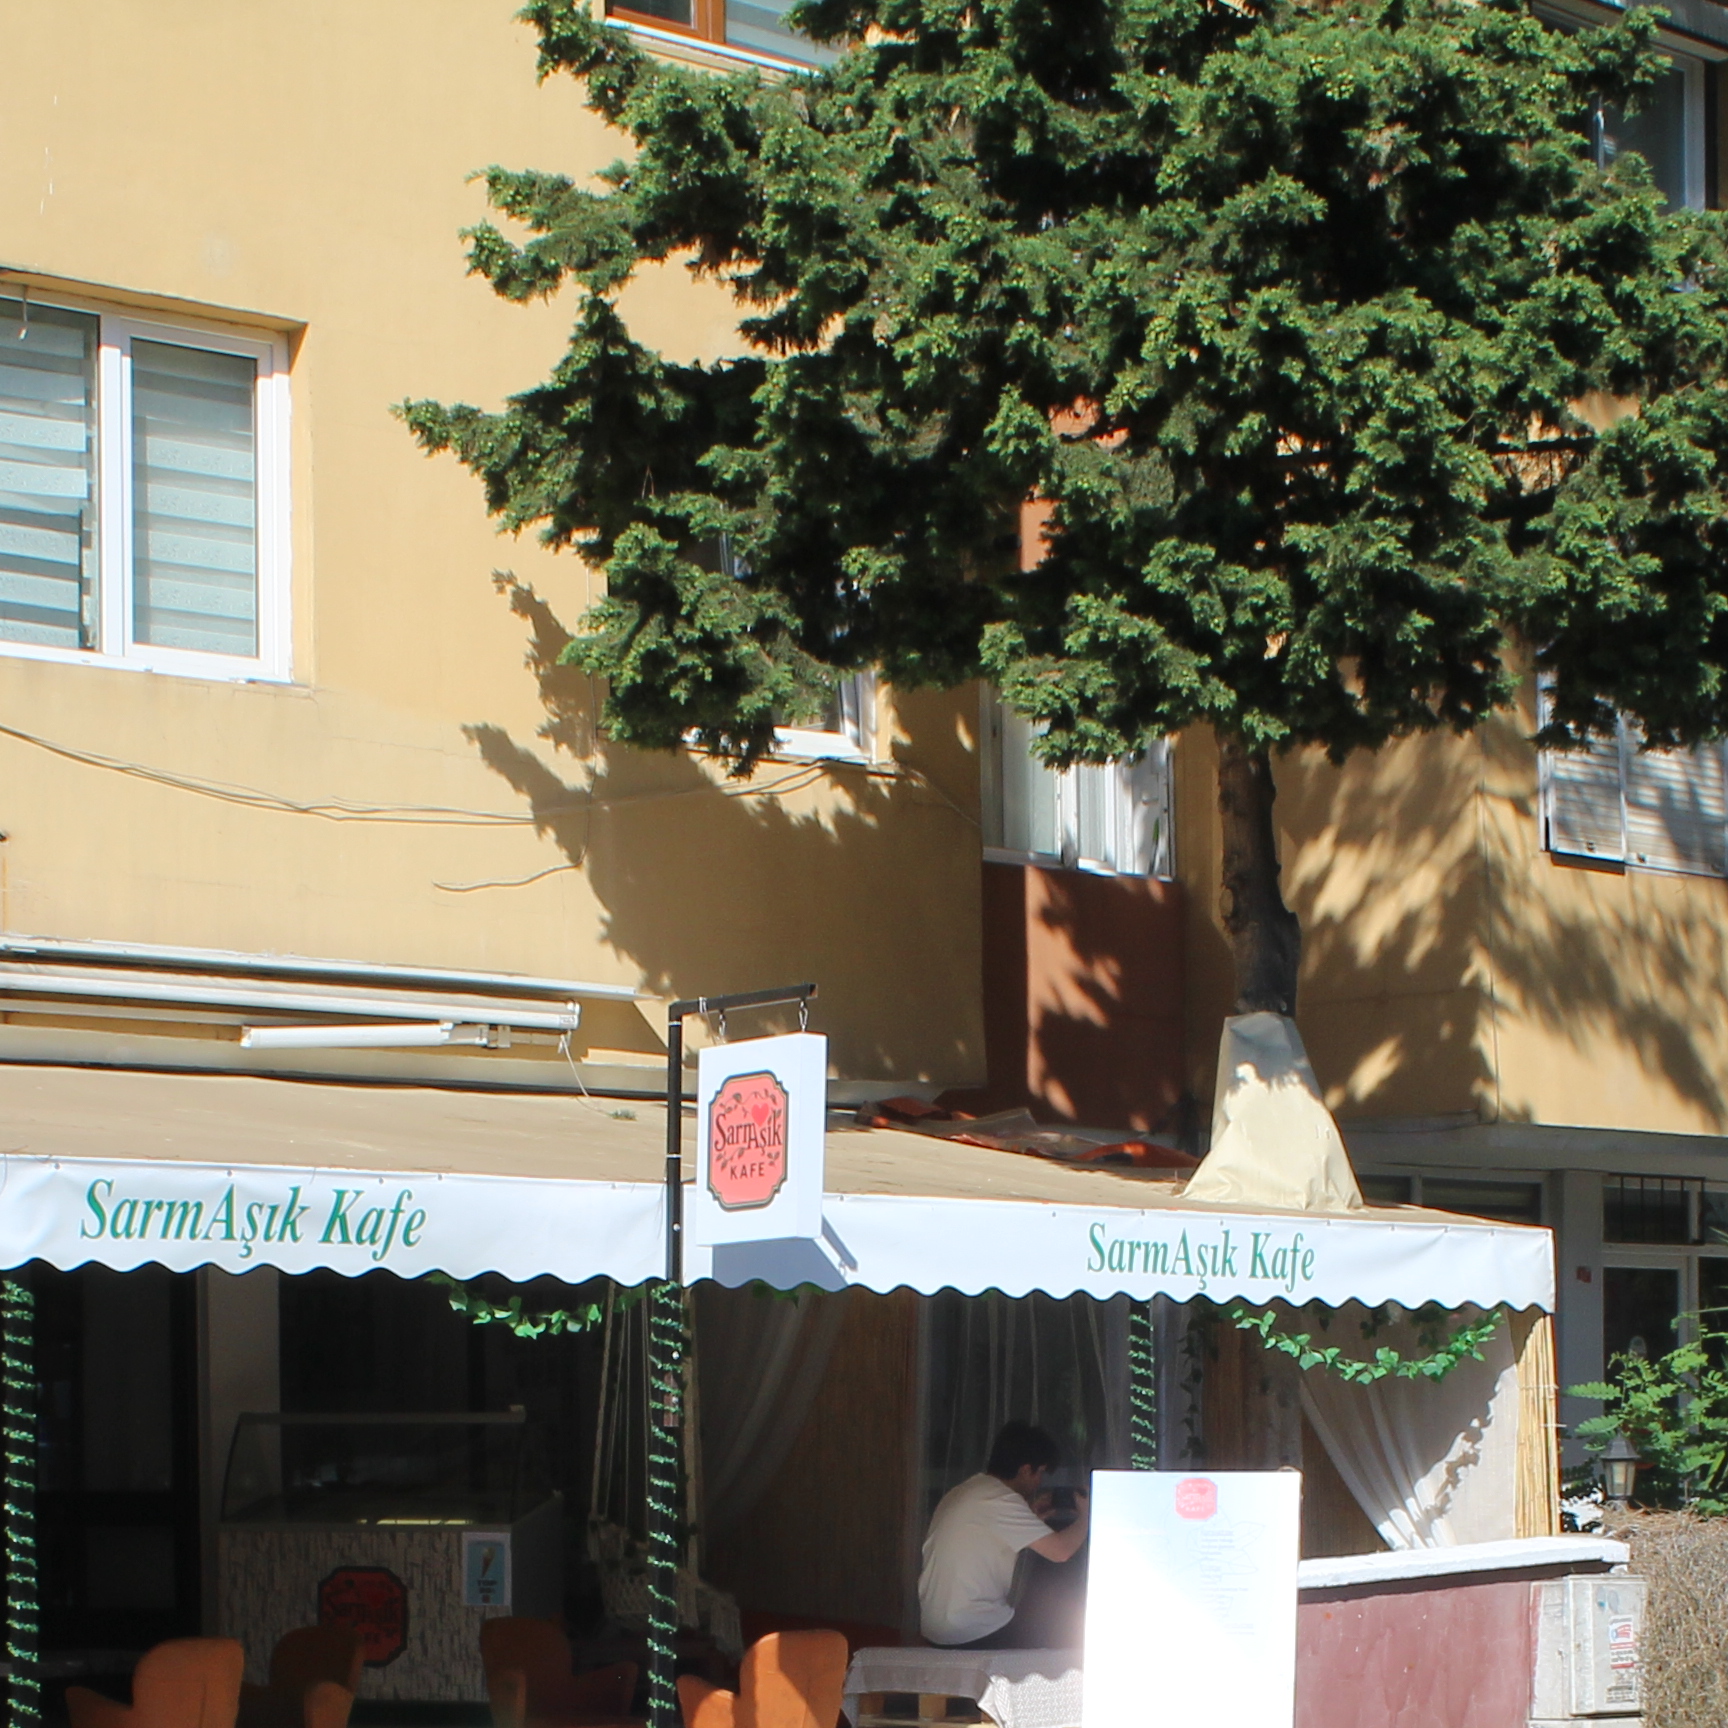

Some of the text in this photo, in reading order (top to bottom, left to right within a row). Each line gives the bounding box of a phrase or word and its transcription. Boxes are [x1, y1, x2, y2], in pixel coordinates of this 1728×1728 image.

[730, 1162, 765, 1180] KAFE
[80, 1178, 427, 1262] SarmAşık Kafe
[1087, 1222, 1315, 1293] SarmAşık Kafe
